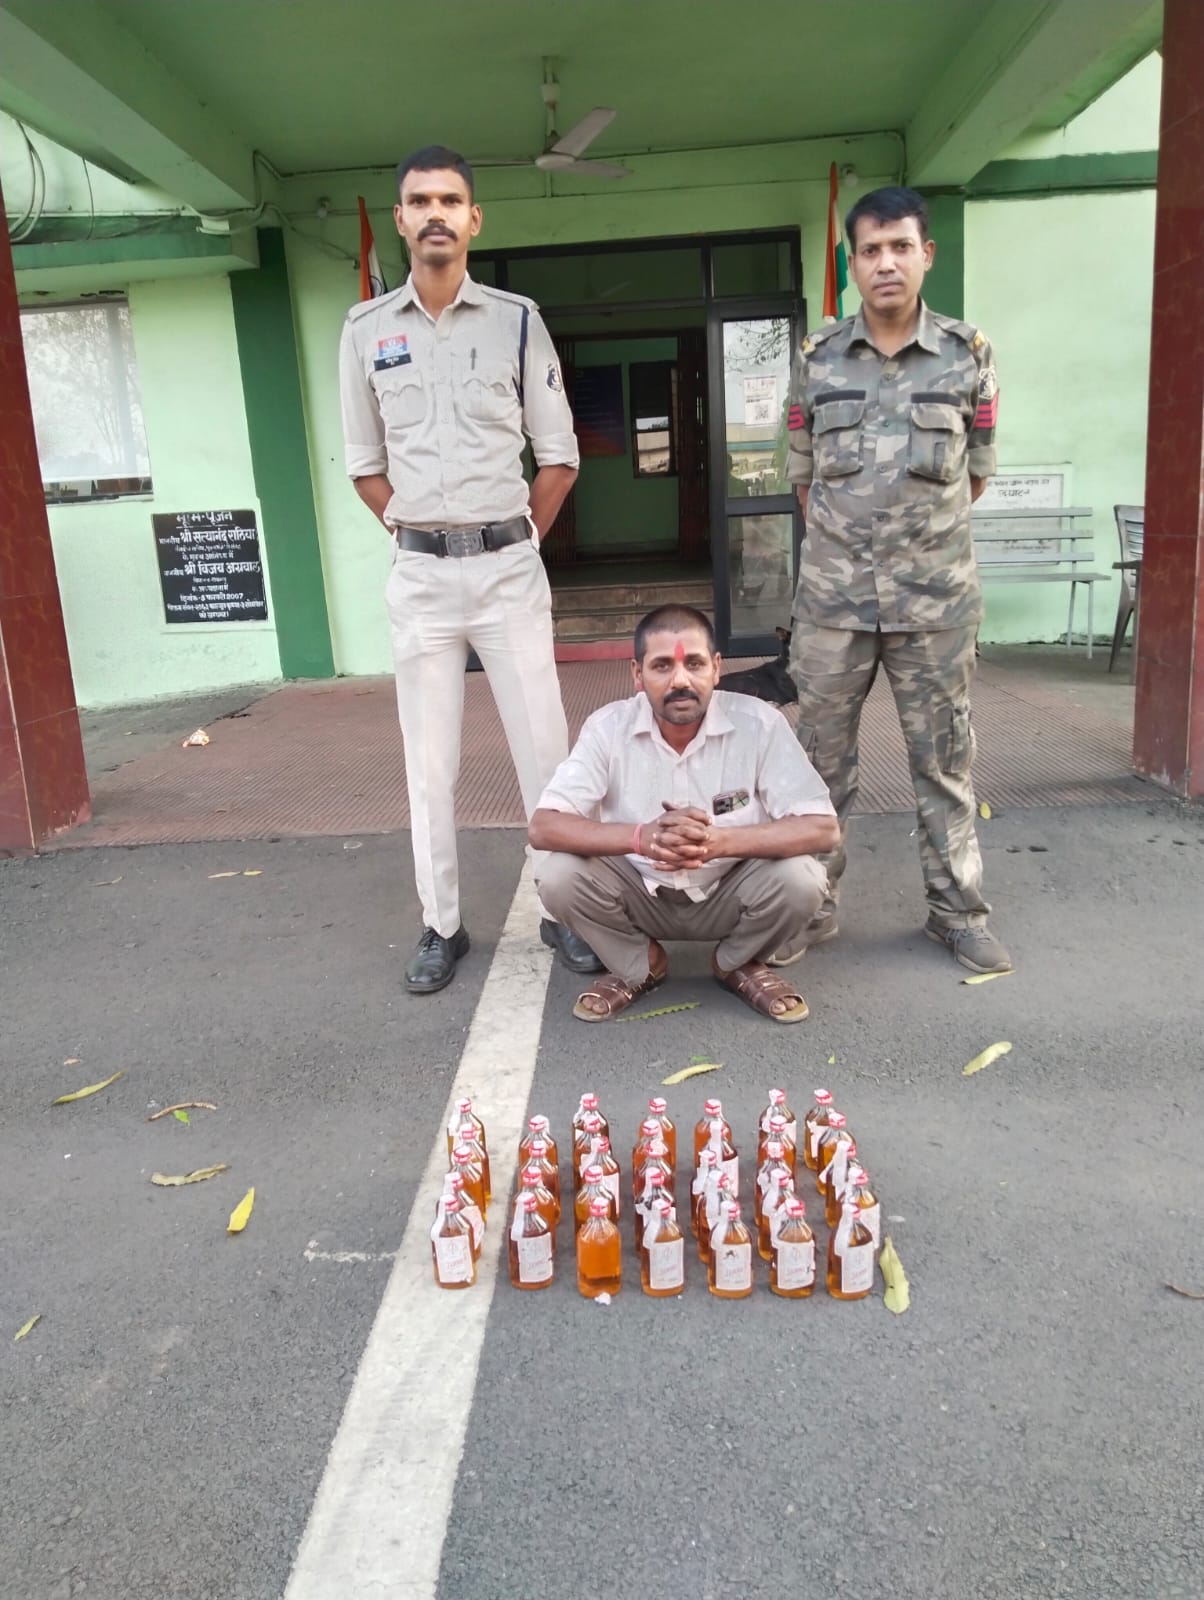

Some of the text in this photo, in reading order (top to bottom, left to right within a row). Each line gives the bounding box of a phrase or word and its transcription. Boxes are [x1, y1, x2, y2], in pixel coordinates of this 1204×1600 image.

[180, 528, 192, 543] श्री
[184, 561, 196, 575] श्री
[197, 561, 225, 575] विजय
